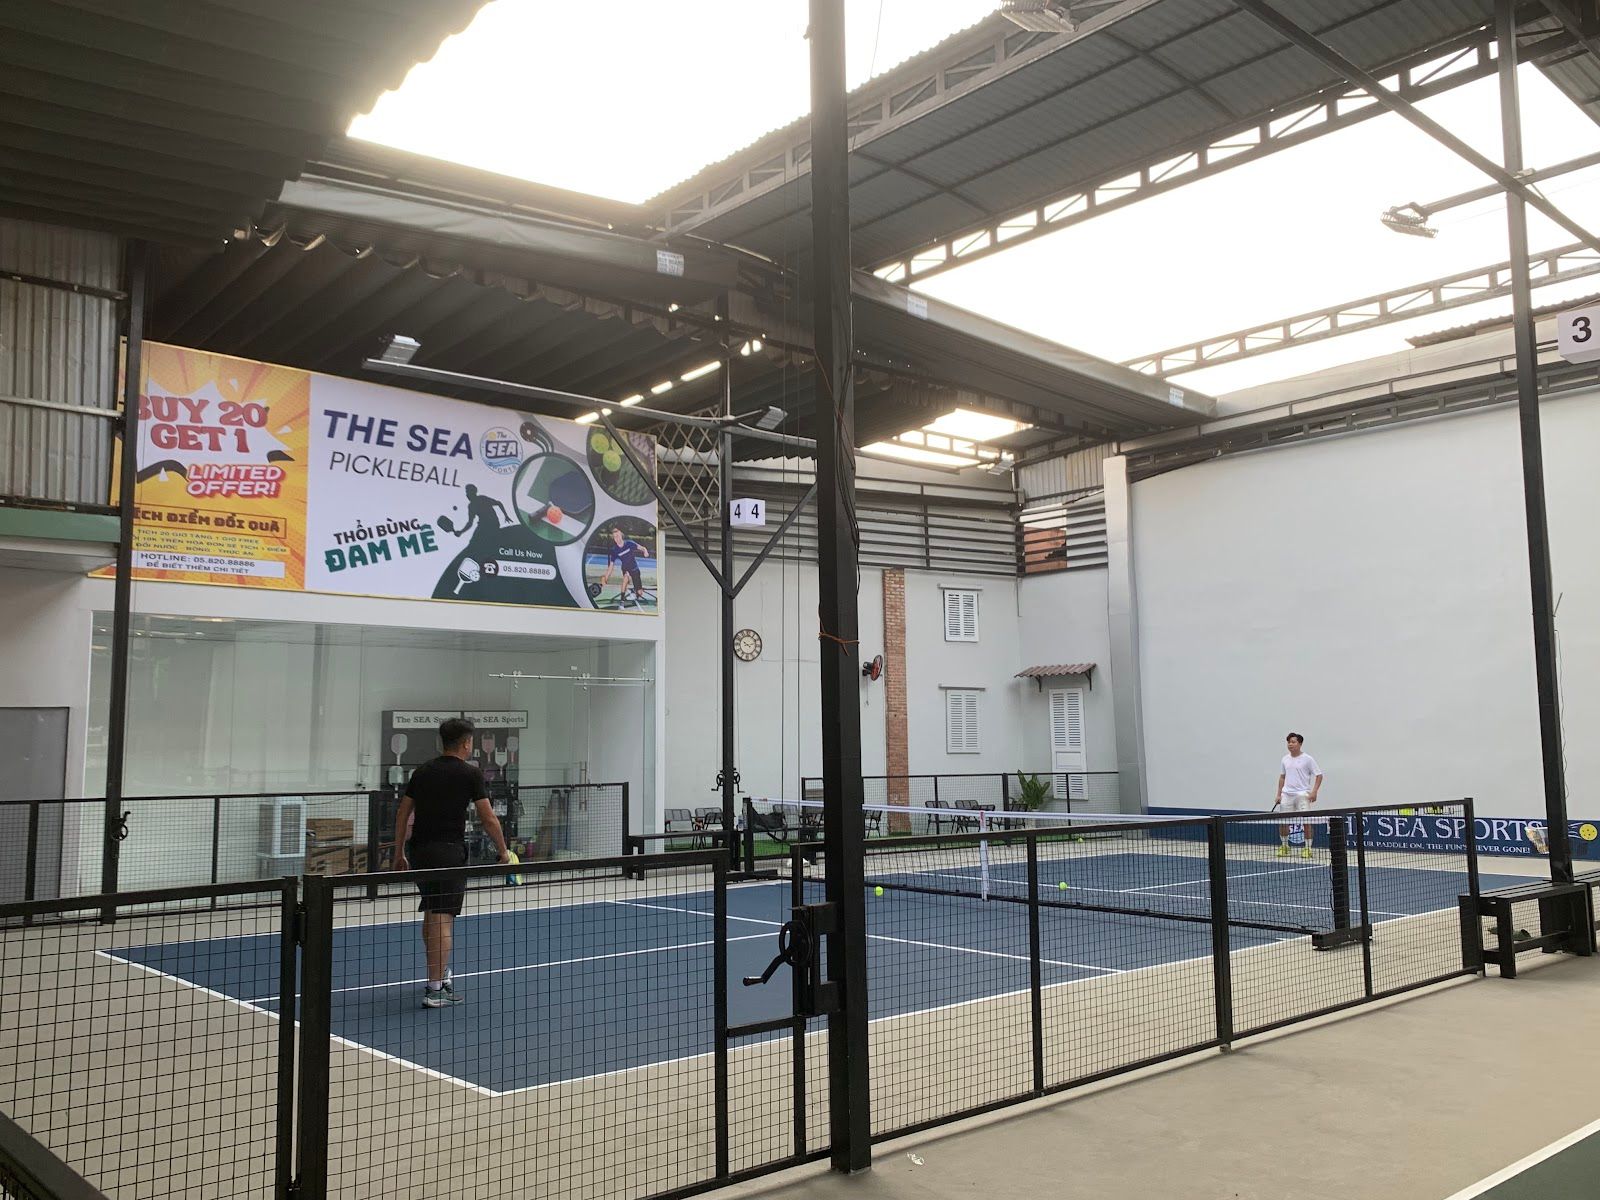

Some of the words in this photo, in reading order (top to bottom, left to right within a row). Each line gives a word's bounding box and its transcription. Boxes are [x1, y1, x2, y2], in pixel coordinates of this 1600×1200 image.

[1572, 316, 1592, 343] 3
[137, 394, 210, 423] BUY
[218, 401, 268, 428] 20
[150, 423, 226, 451] GET
[234, 428, 250, 453] 1
[323, 409, 398, 448] THE
[406, 424, 473, 460] SEA
[486, 440, 518, 458] SEA
[188, 464, 284, 481] LIMITED
[329, 451, 462, 488] PICKLEBALL
[187, 480, 279, 497] OFFER!
[133, 507, 163, 521] ÍCH
[166, 508, 211, 526] ĐIỂM
[734, 503, 741, 519] 4
[751, 503, 760, 519] 4
[333, 519, 374, 545] THỔI
[376, 517, 421, 538] BÙNG
[324, 539, 392, 573] ĐAM
[397, 523, 439, 558] MÊ
[498, 547, 514, 556] Call
[515, 549, 525, 557] Us
[526, 550, 543, 559] Now
[140, 552, 191, 563] HOTLINE:
[395, 716, 411, 724] The
[413, 716, 431, 724] SEA
[482, 716, 499, 724] SEA
[501, 716, 526, 725] Sports
[1378, 816, 1429, 838] SEA
[1353, 840, 1374, 848] YUR
[1376, 841, 1408, 849] PADDLE
[1502, 845, 1530, 854] GONE!
